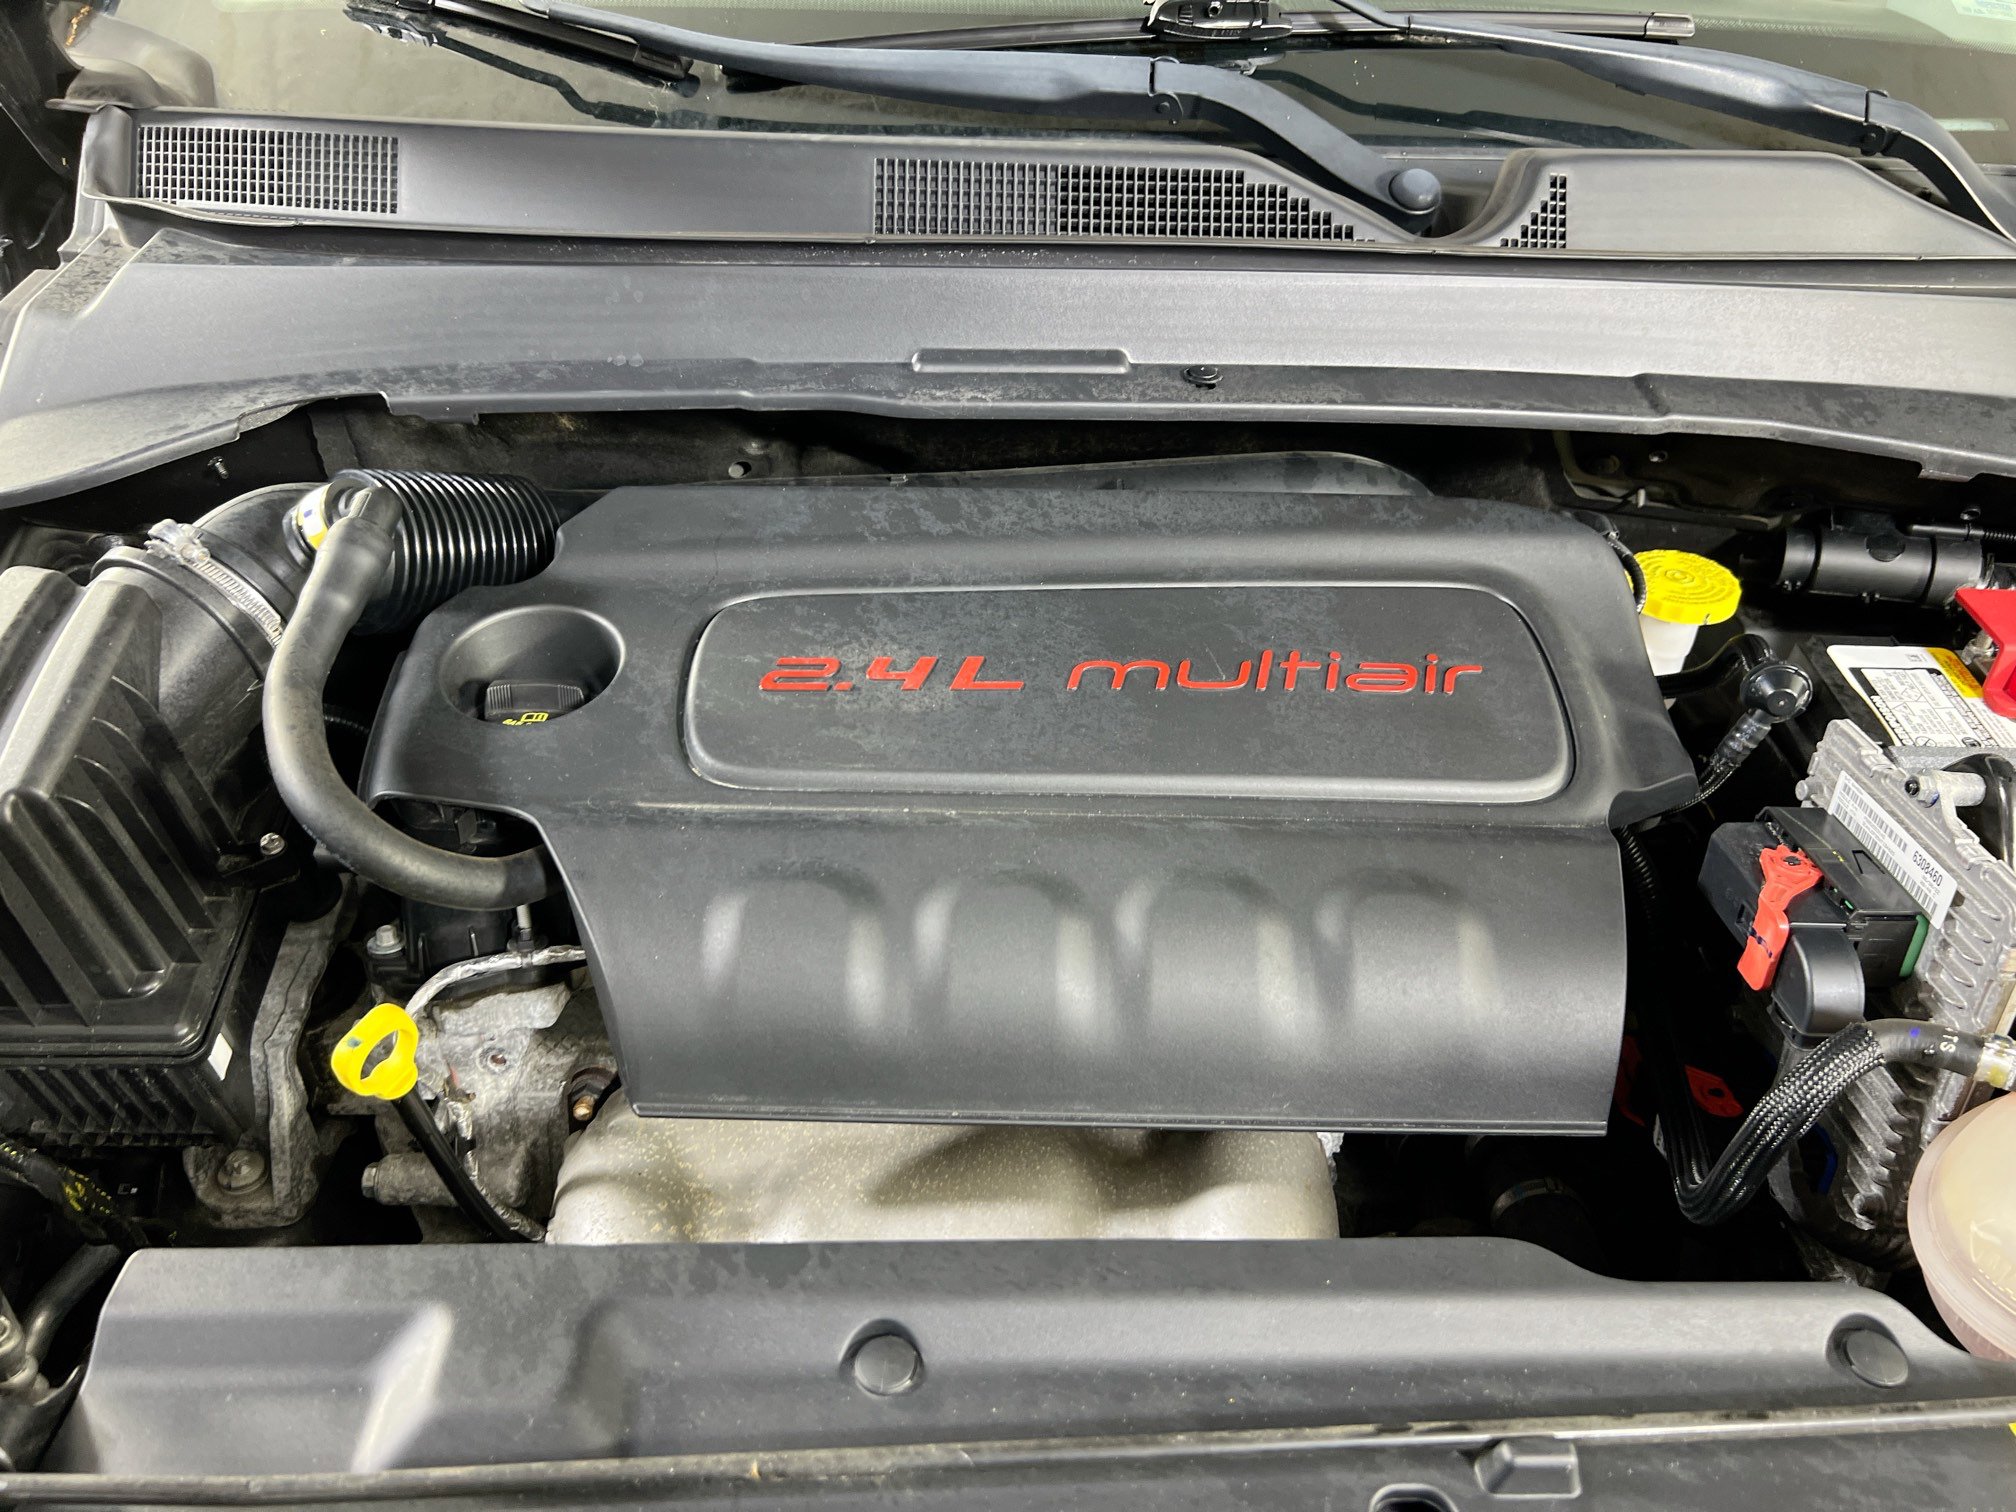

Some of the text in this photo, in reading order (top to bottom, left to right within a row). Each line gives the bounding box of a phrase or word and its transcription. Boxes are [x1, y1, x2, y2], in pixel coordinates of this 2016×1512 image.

[760, 649, 1482, 695] 2.4L multiair
[1912, 850, 1944, 887] 6308460
